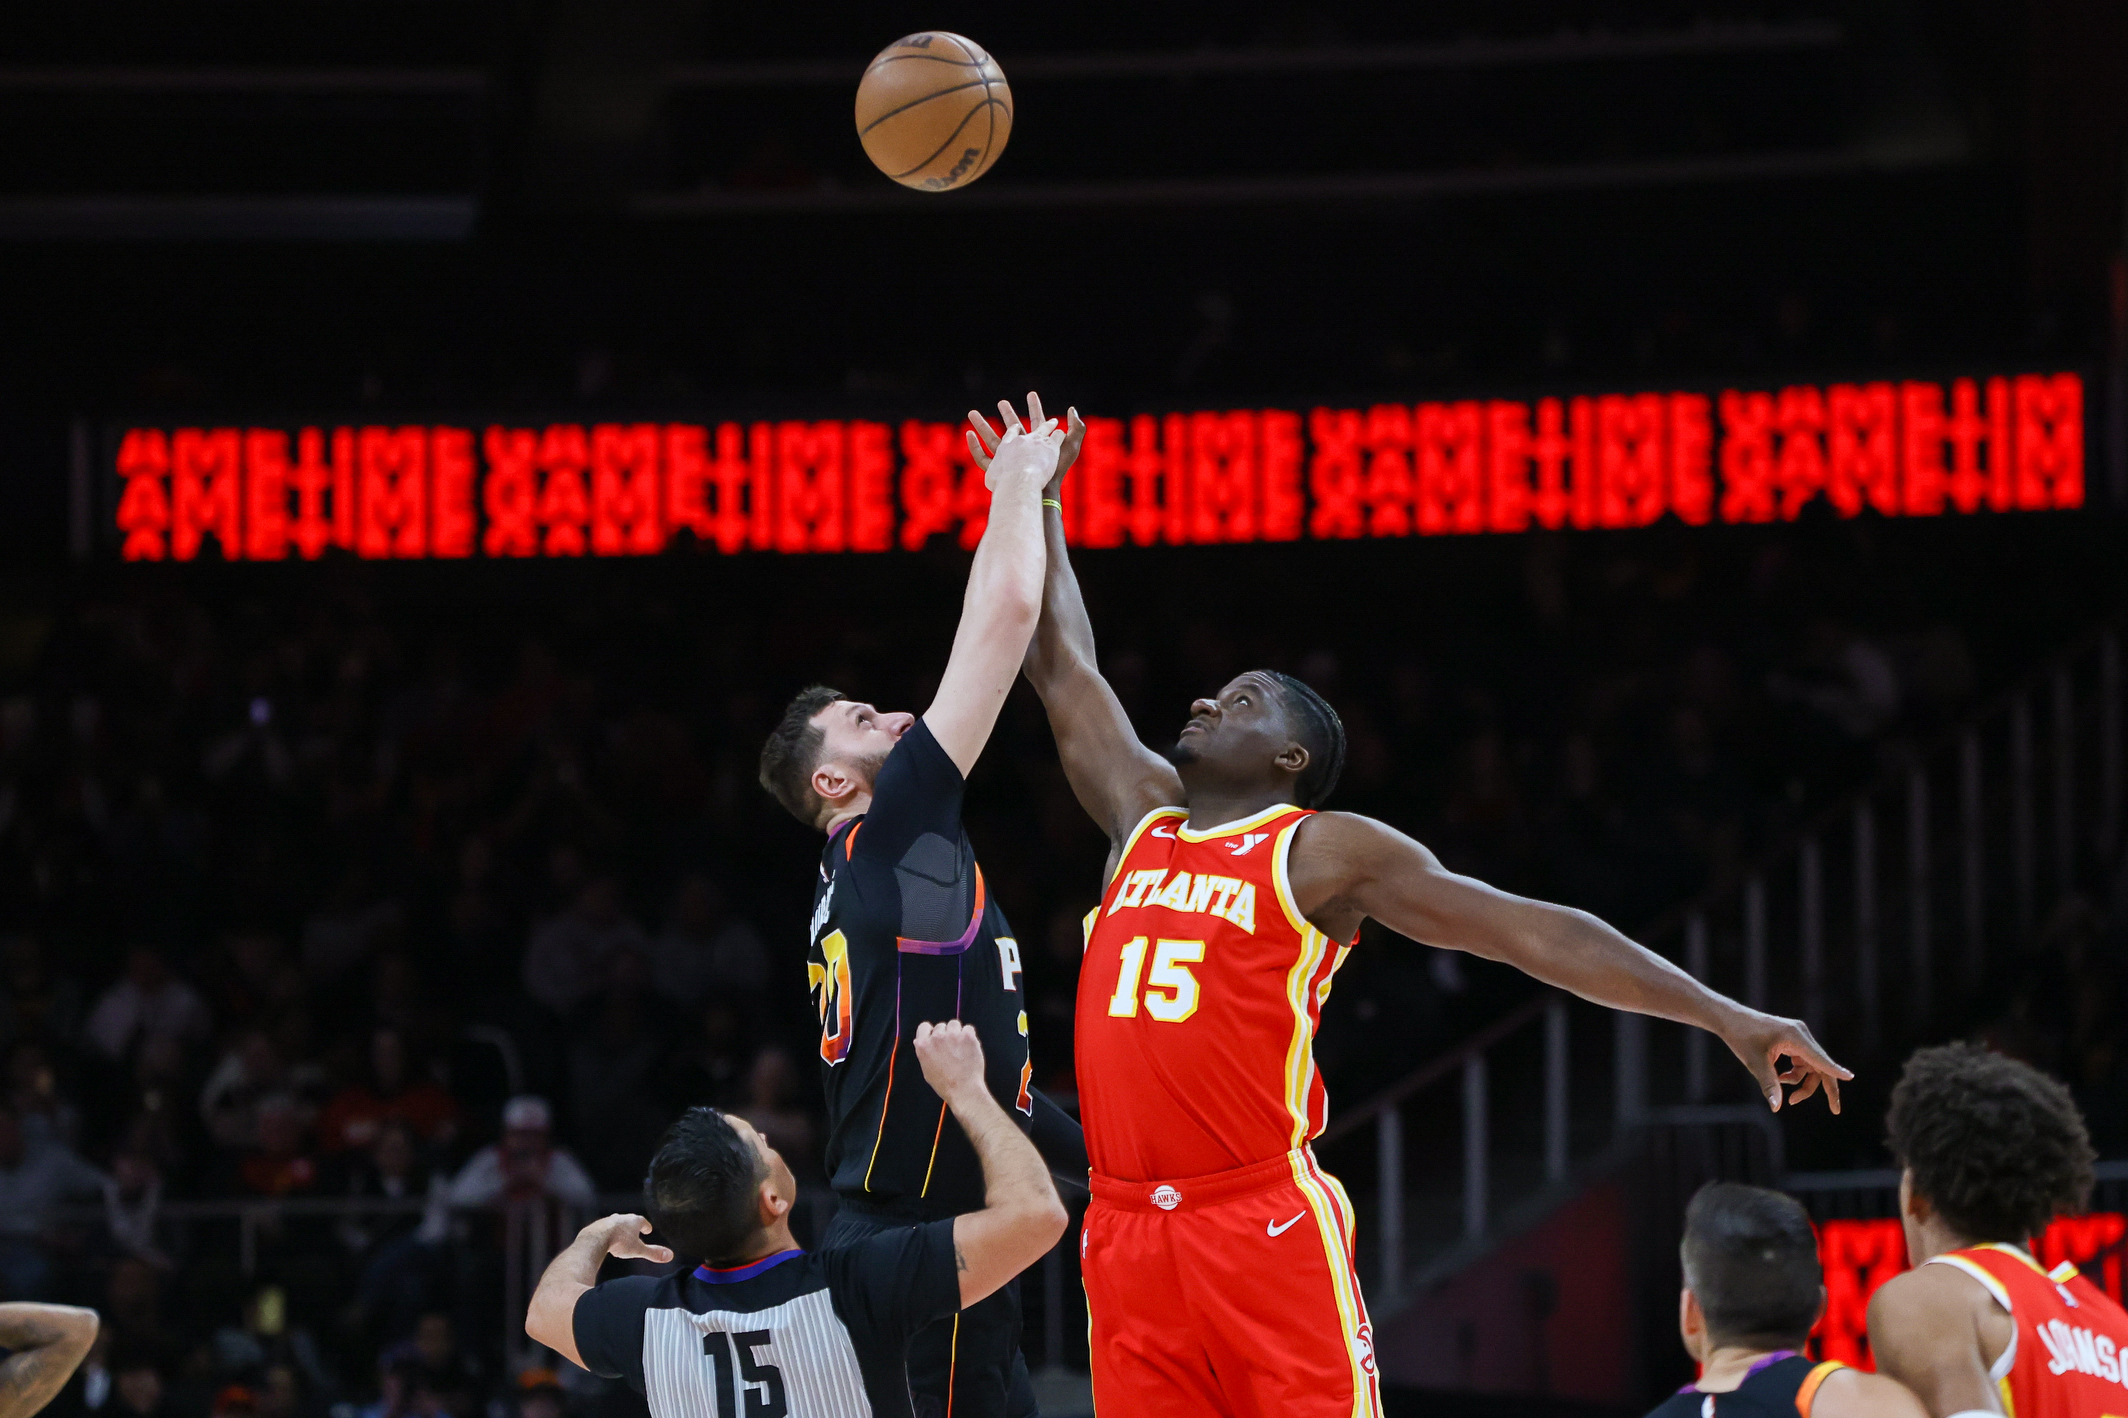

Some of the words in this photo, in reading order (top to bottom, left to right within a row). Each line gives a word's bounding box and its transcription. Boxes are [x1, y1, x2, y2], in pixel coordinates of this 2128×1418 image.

[1224, 841, 1239, 849] the
[1106, 868, 1257, 936] ATLANTA
[1108, 936, 1206, 1024] 15
[1150, 1192, 1183, 1205] HAWKS
[703, 1329, 788, 1418] 15
